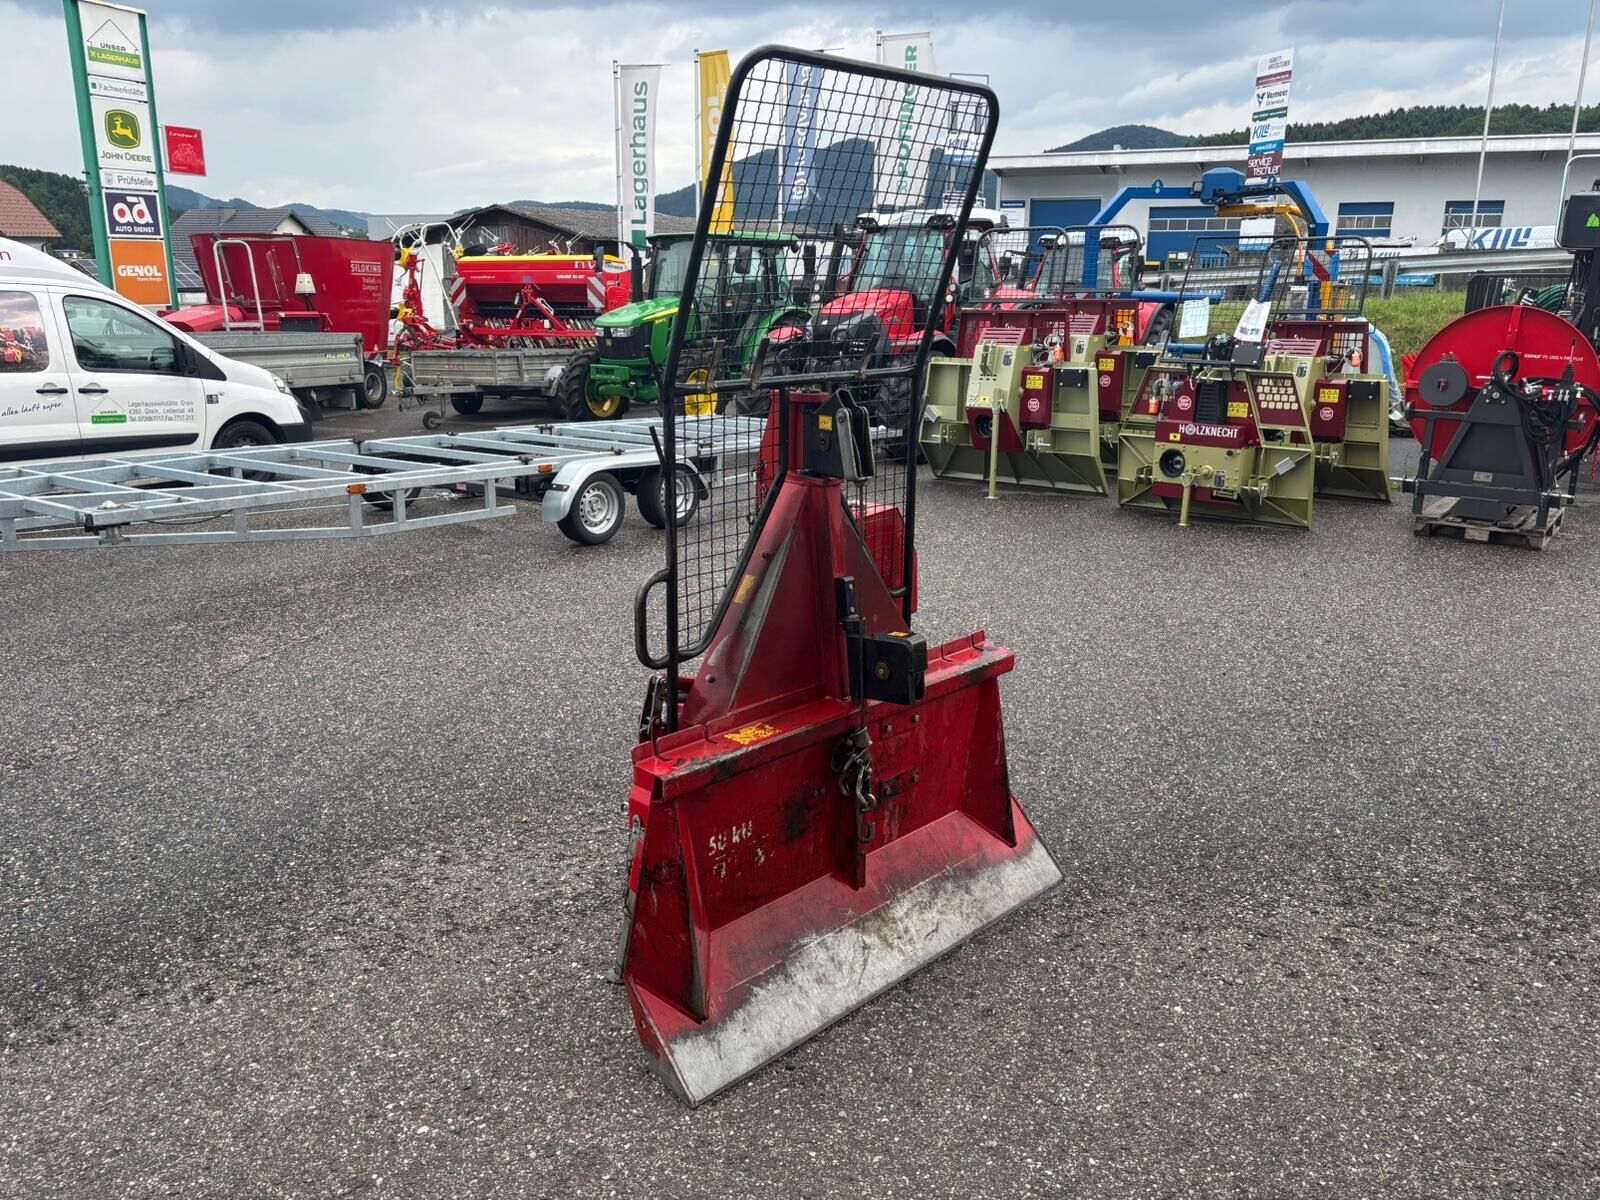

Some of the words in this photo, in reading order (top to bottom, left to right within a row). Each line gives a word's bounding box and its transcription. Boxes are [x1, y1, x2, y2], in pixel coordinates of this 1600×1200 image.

[100, 42, 126, 51] UNSER
[1266, 89, 1288, 99] Vermeer
[101, 150, 123, 160] JOHN
[125, 152, 152, 163] DEERE
[629, 80, 648, 225] Lagerhaus
[1247, 156, 1272, 168] service
[117, 175, 153, 186] Prüfstelle
[118, 265, 162, 277] GENOL
[351, 263, 381, 273] SILOKING
[1, 407, 18, 417] alles
[21, 403, 41, 414] läuft
[1179, 424, 1239, 438] HOLZKNECHT
